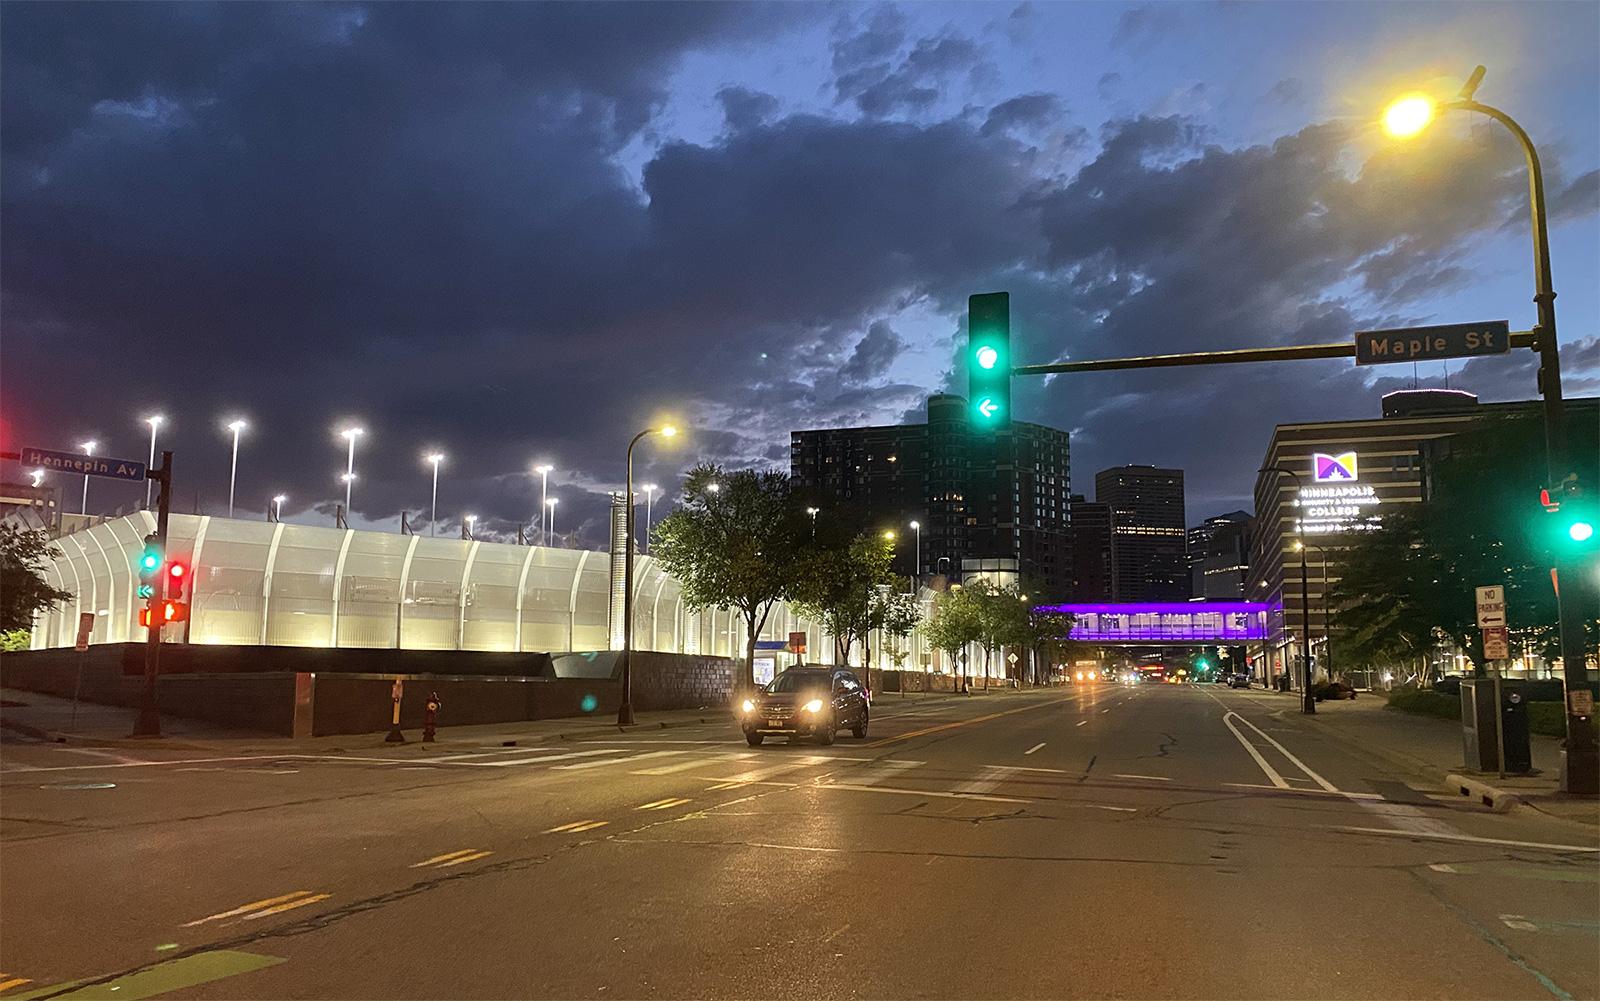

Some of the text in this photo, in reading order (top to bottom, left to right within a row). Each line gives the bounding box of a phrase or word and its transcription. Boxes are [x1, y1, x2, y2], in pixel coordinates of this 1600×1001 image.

[1371, 332, 1493, 357] Maple St
[30, 452, 137, 476] Hennepin Av
[1309, 506, 1360, 517] COLLEGE
[1484, 590, 1495, 600] NO
[1478, 602, 1503, 613] PARKING
